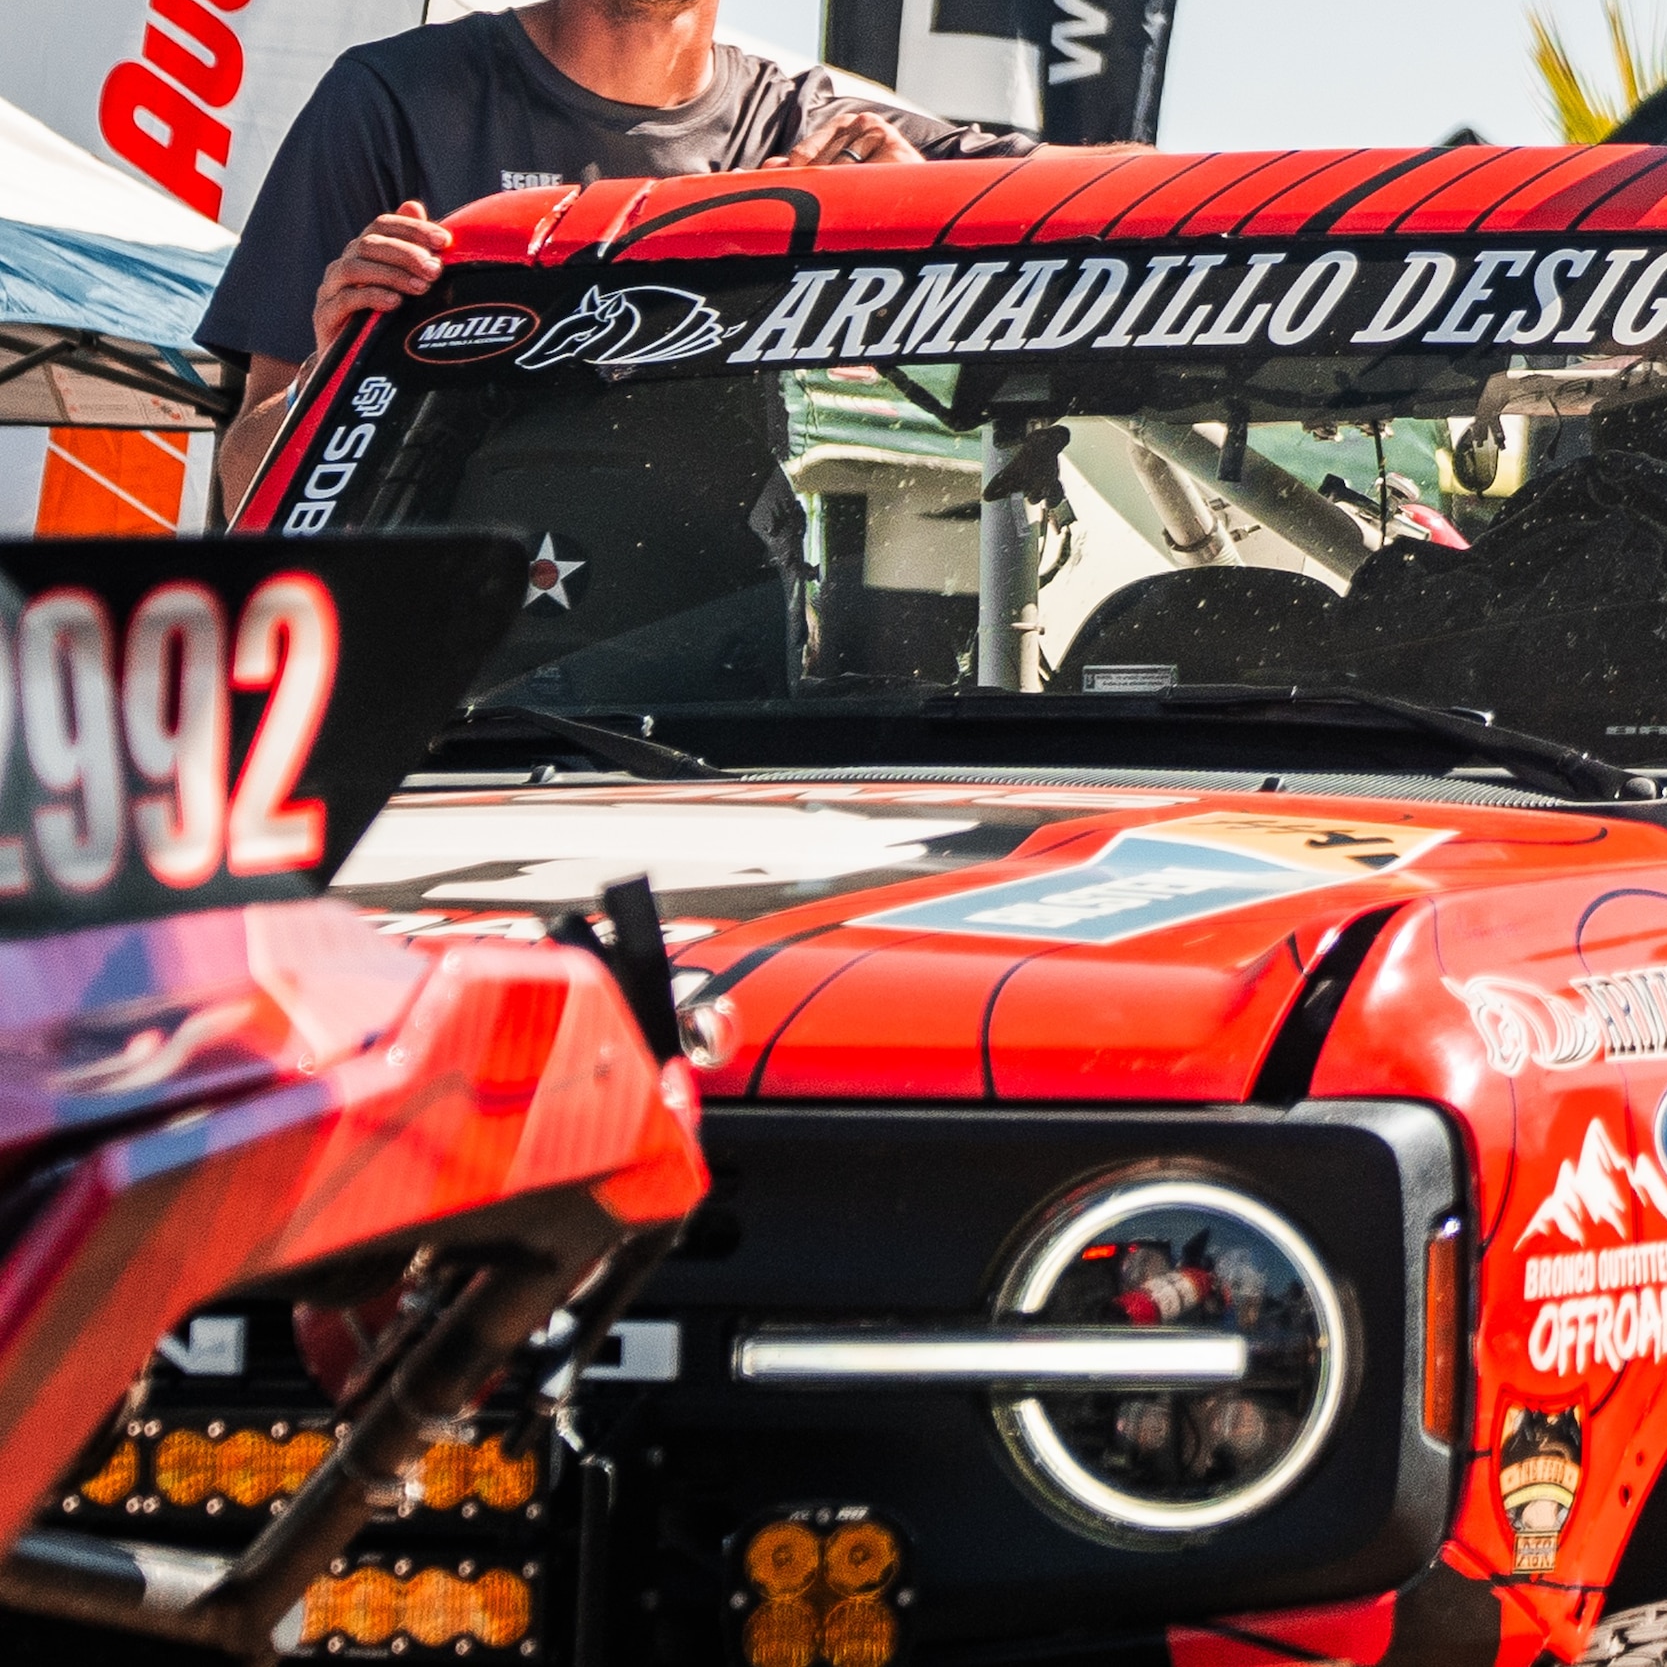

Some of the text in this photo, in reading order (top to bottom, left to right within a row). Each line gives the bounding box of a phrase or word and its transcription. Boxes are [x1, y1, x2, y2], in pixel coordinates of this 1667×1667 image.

[501, 171, 562, 190] SCORE
[727, 249, 1360, 365] ARMADILLO
[0, 571, 341, 894] 992
[1524, 1251, 1595, 1301] BRONCO
